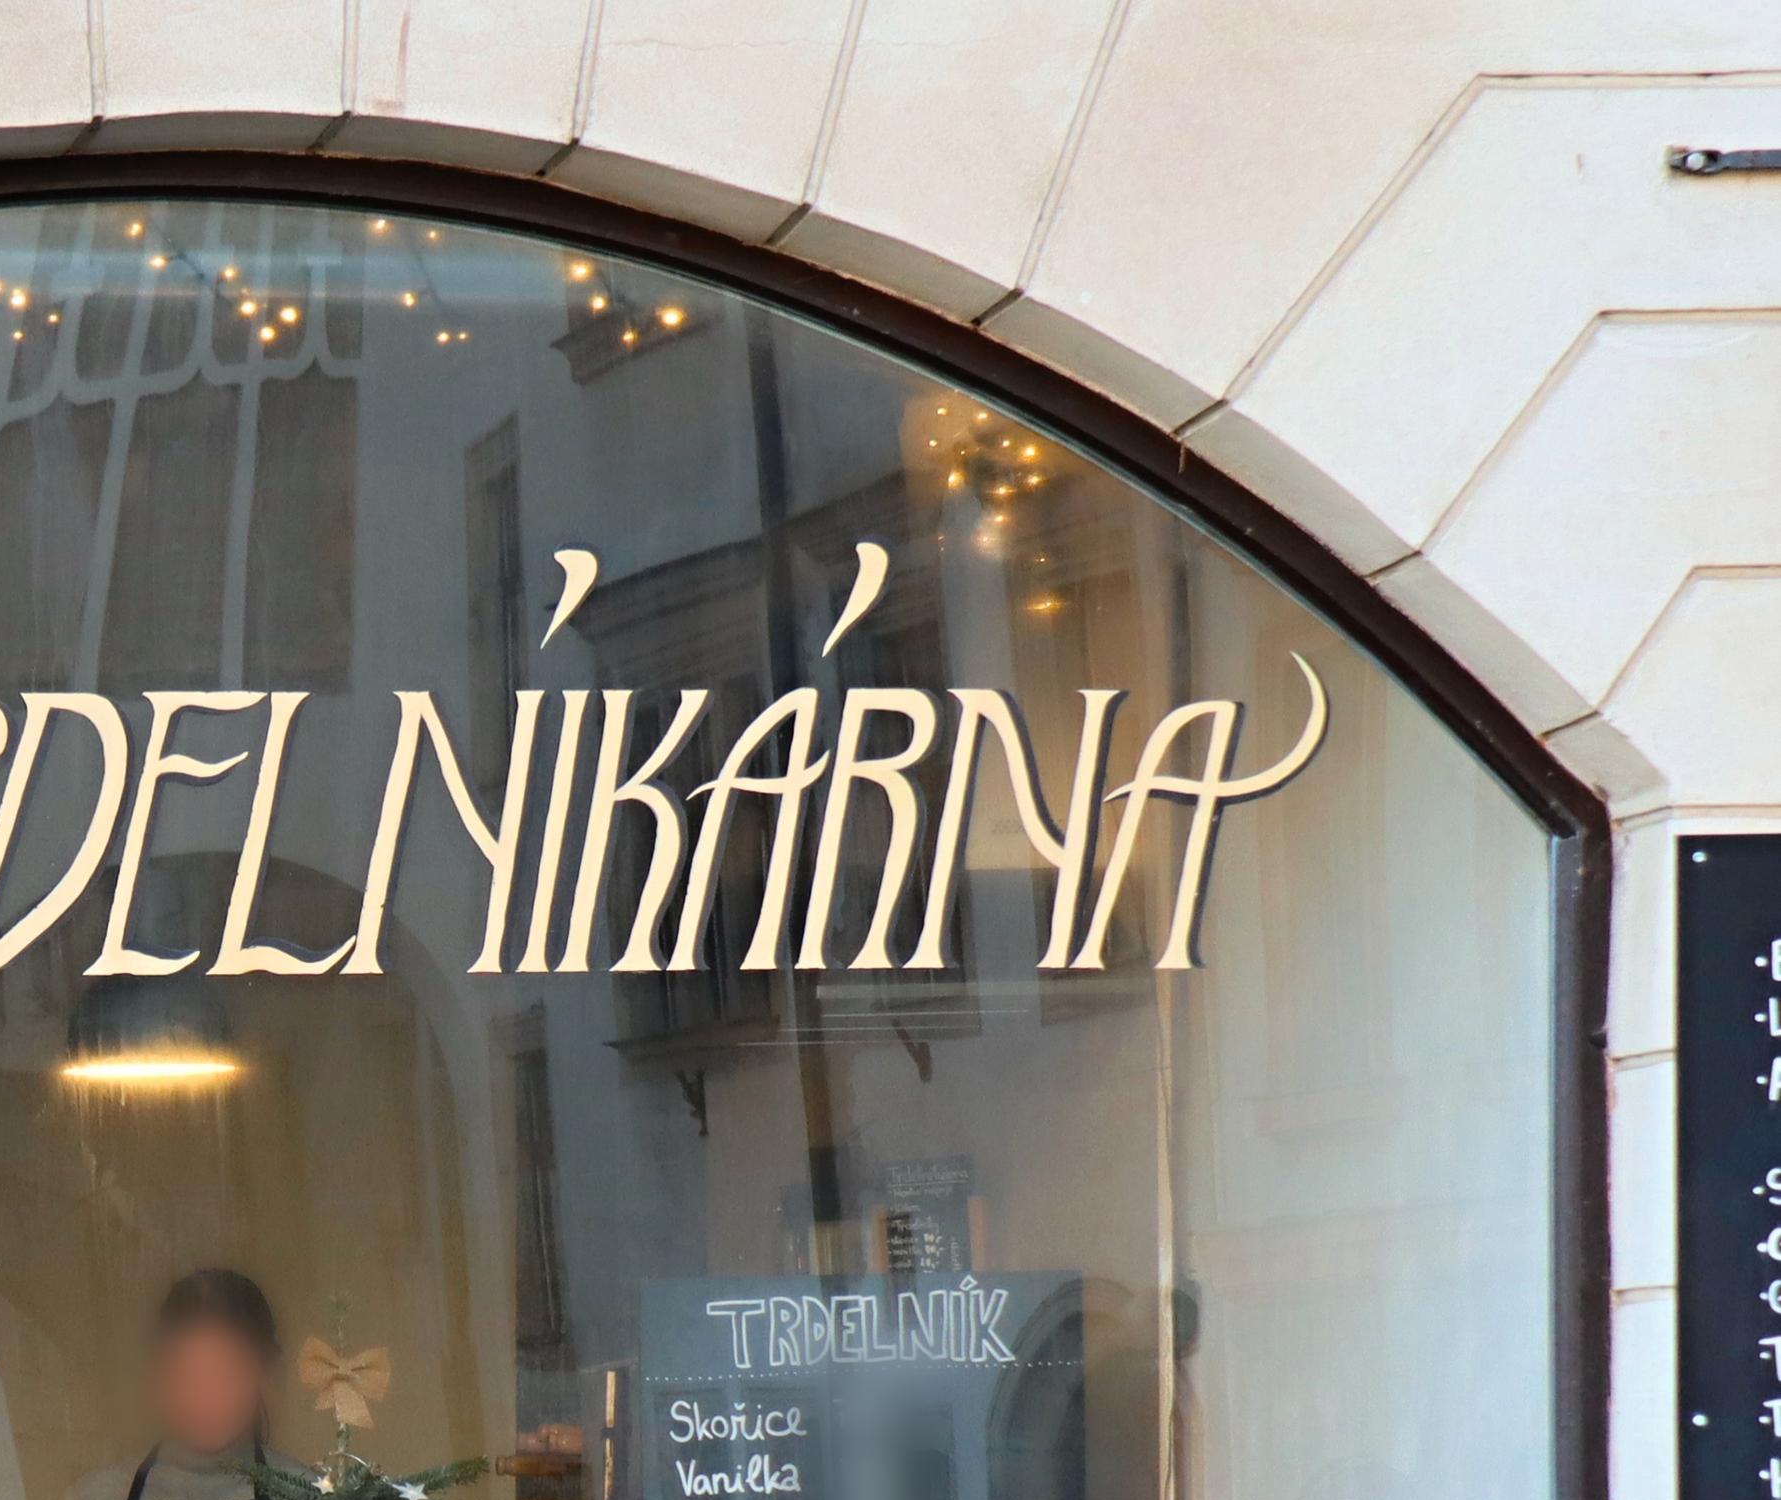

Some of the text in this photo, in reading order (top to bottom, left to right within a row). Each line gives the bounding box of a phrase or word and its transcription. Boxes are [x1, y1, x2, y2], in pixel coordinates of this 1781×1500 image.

[706, 1274, 1016, 1369] TRDELNÍK
[669, 1400, 806, 1443] Skořice
[675, 1454, 801, 1497] Vanilka
